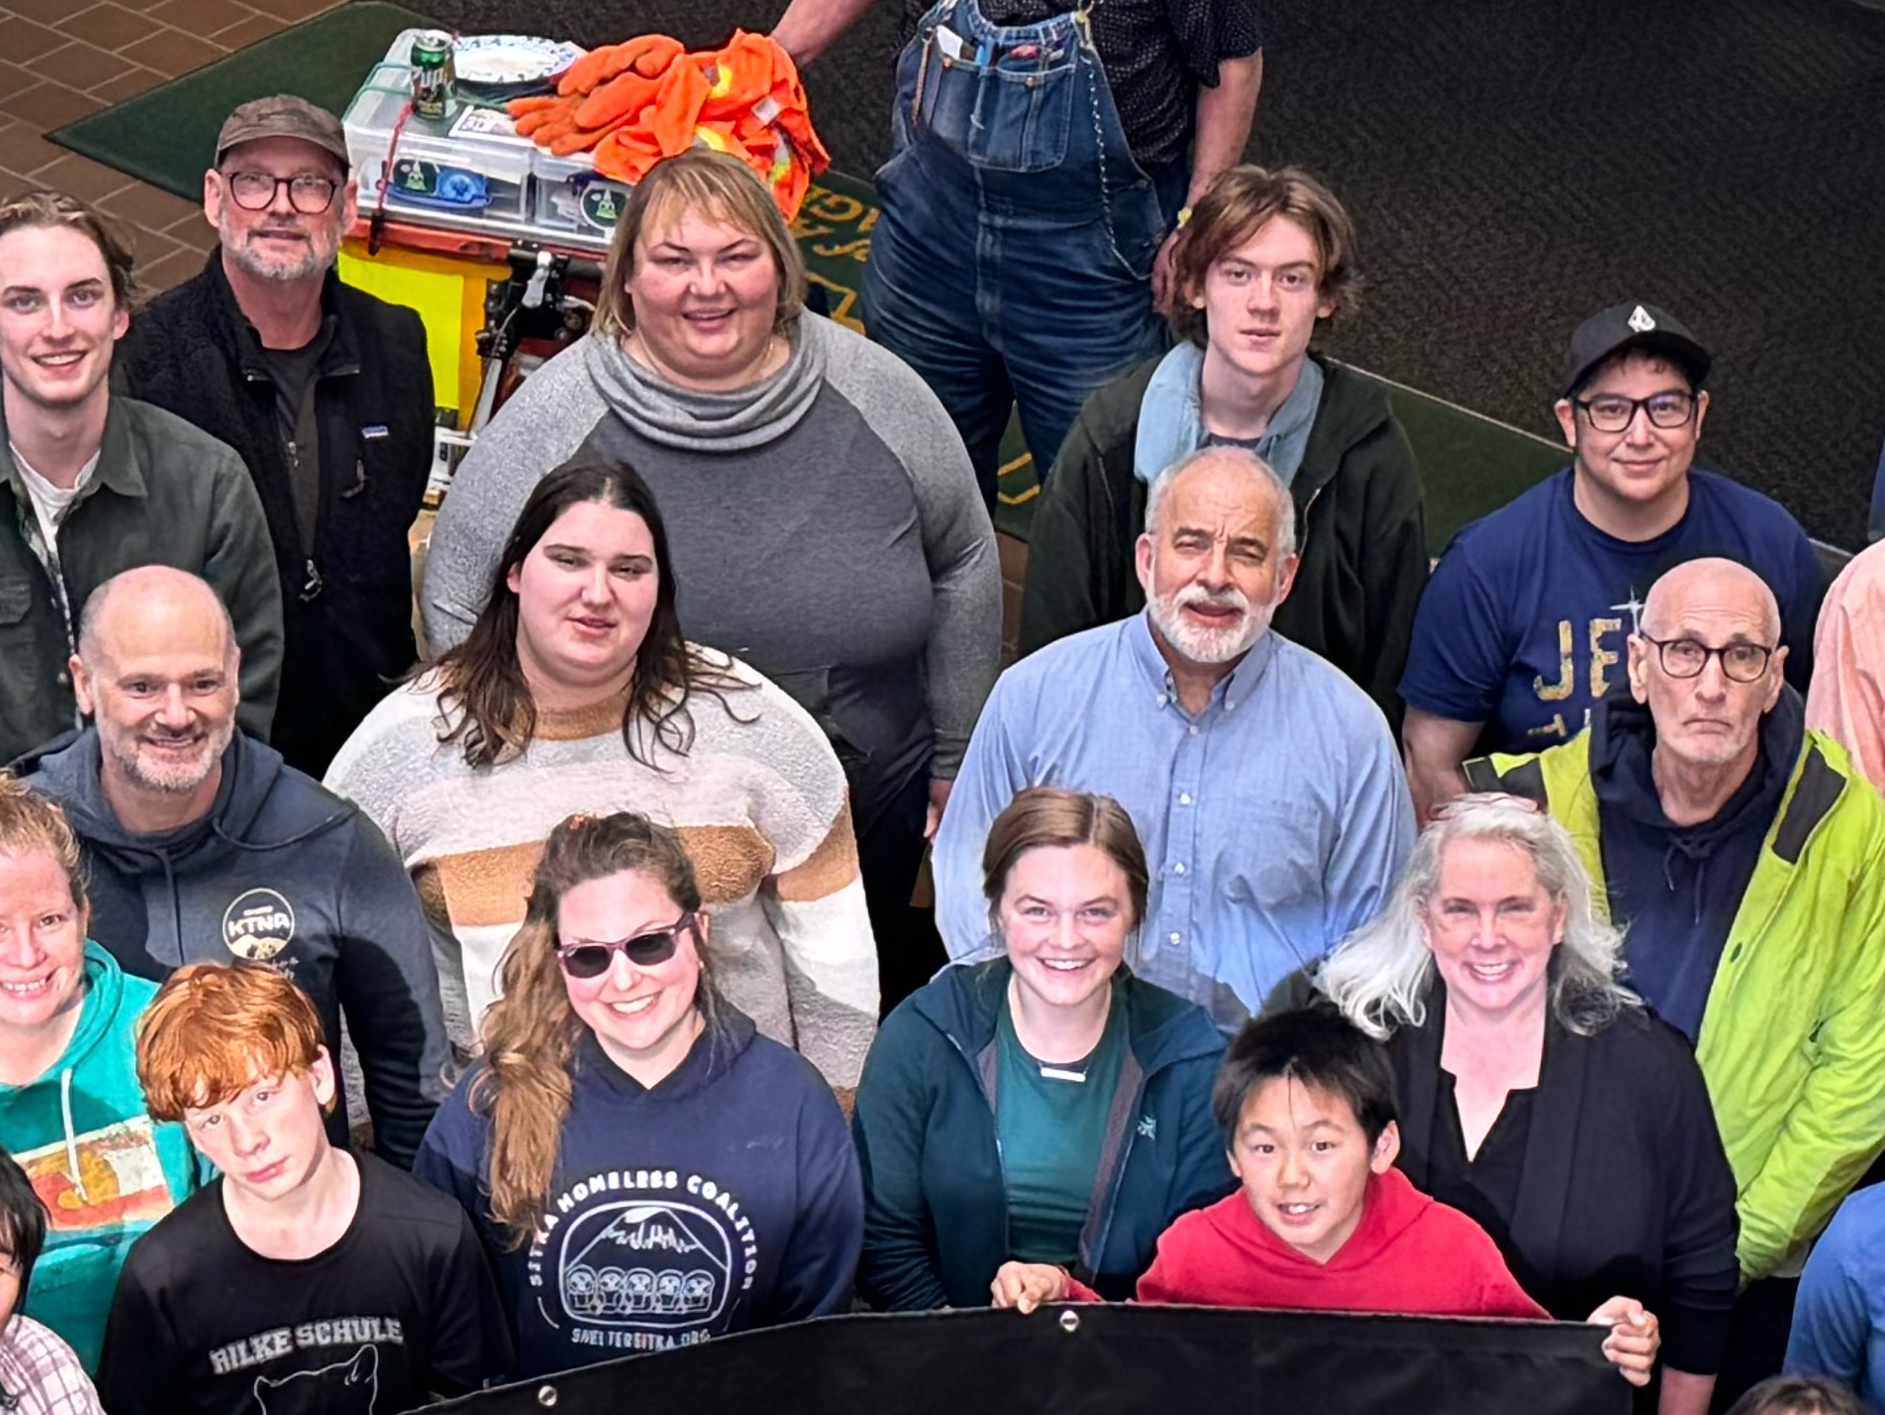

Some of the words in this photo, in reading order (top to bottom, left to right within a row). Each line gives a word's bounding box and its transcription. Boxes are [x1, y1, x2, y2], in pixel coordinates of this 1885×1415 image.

[228, 912, 291, 937] KTNA
[557, 1169, 678, 1214] HOMELESS
[686, 1174, 758, 1290] COALITION
[209, 1326, 295, 1376] RILKE
[294, 1316, 404, 1347] SCHULE
